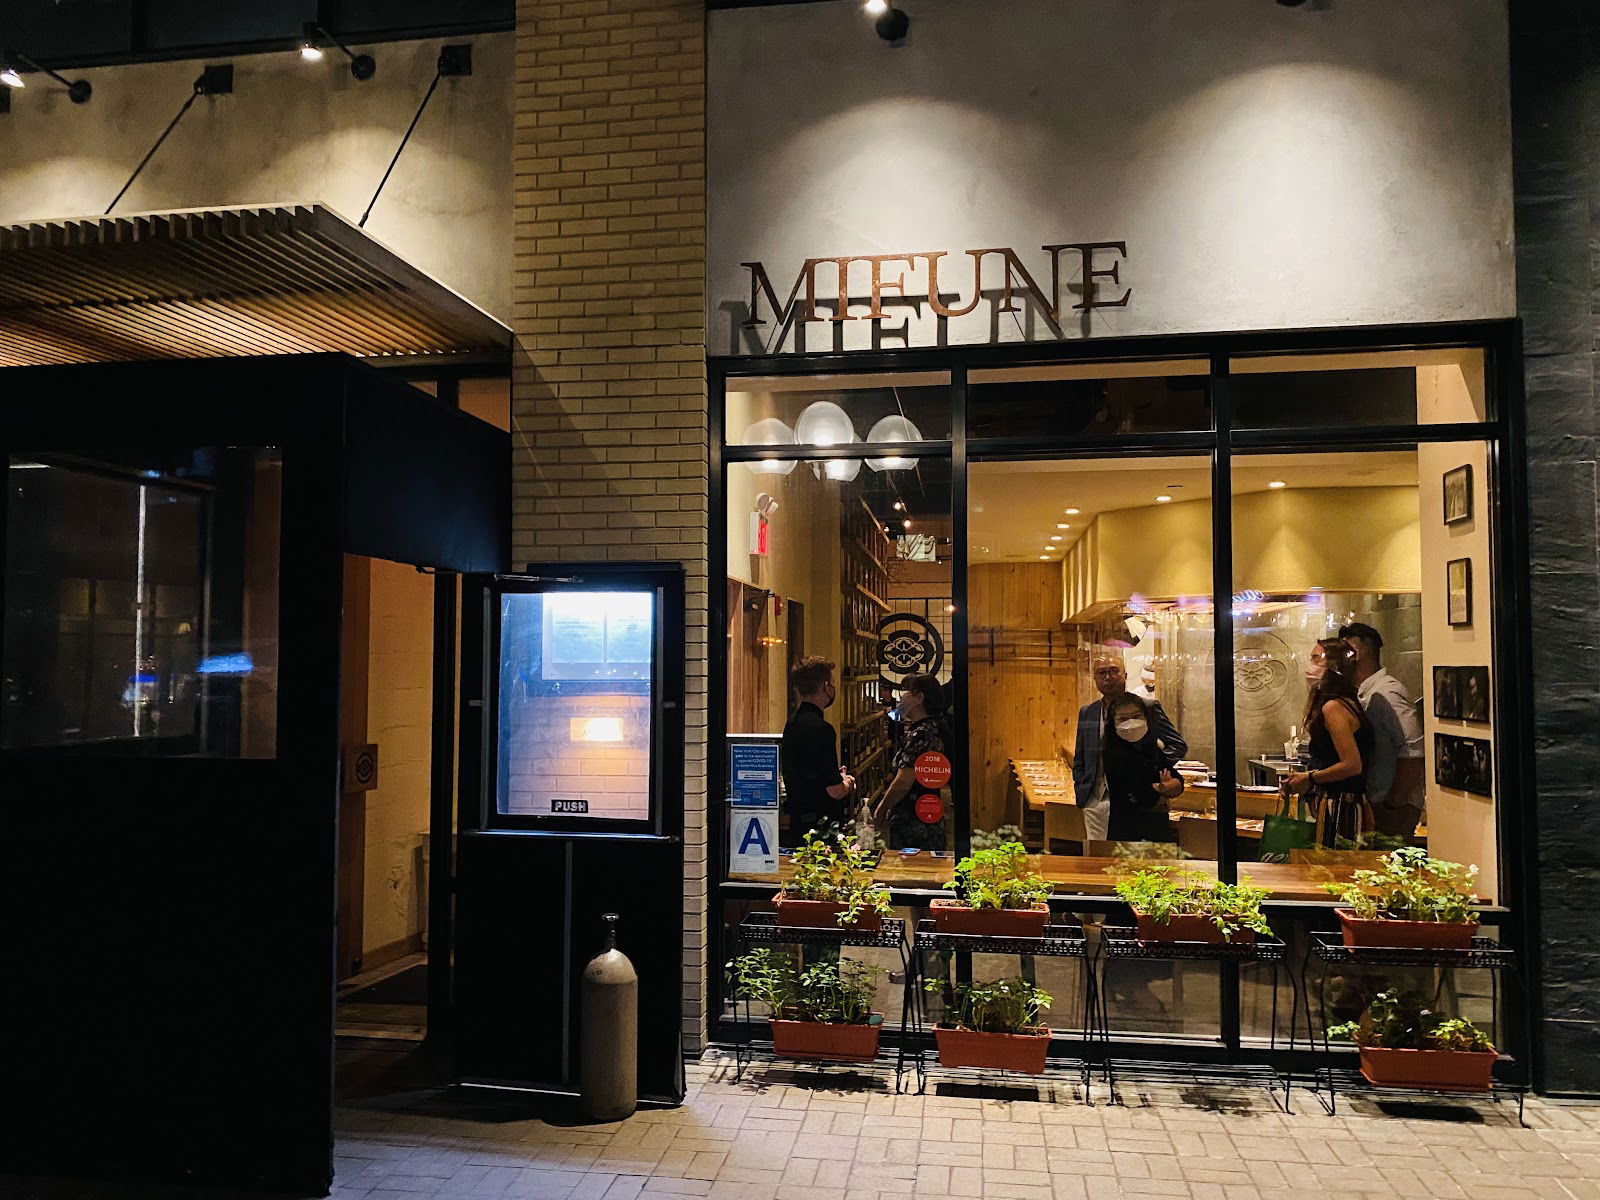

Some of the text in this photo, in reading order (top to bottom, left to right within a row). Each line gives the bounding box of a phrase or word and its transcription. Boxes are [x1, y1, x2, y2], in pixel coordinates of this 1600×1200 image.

[741, 241, 1131, 328] MIFUNE
[914, 766, 951, 774] MICHELIN
[555, 801, 586, 812] PUSH
[738, 817, 771, 855] A
